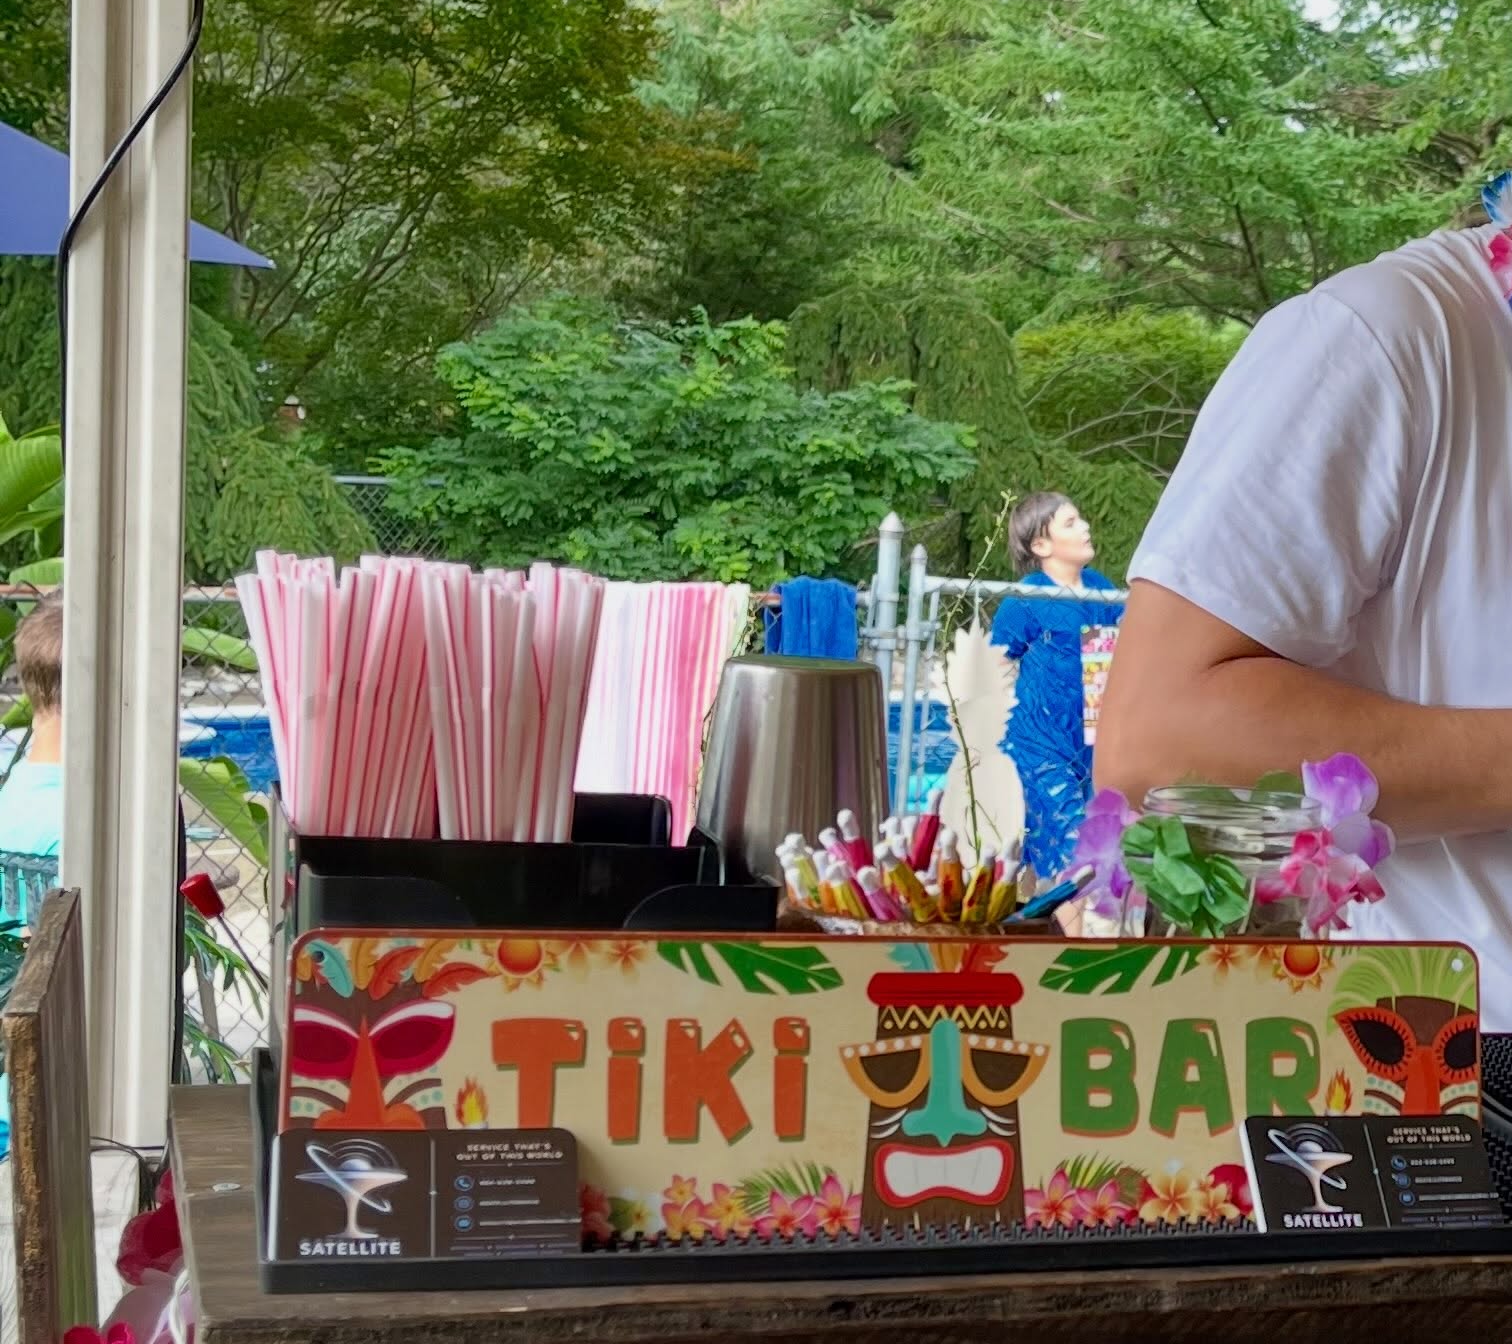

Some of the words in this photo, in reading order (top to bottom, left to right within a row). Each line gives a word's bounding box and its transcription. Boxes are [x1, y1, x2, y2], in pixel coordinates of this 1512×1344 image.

[1059, 1015, 1323, 1140] BAR
[1393, 1127, 1428, 1135] SERVICE
[1387, 1136, 1404, 1144] OUT
[1442, 1134, 1472, 1143] WORLD
[467, 1143, 510, 1152] SERVICE
[1282, 1212, 1364, 1229] SATELLITE
[299, 1241, 401, 1256] SATELLITE
